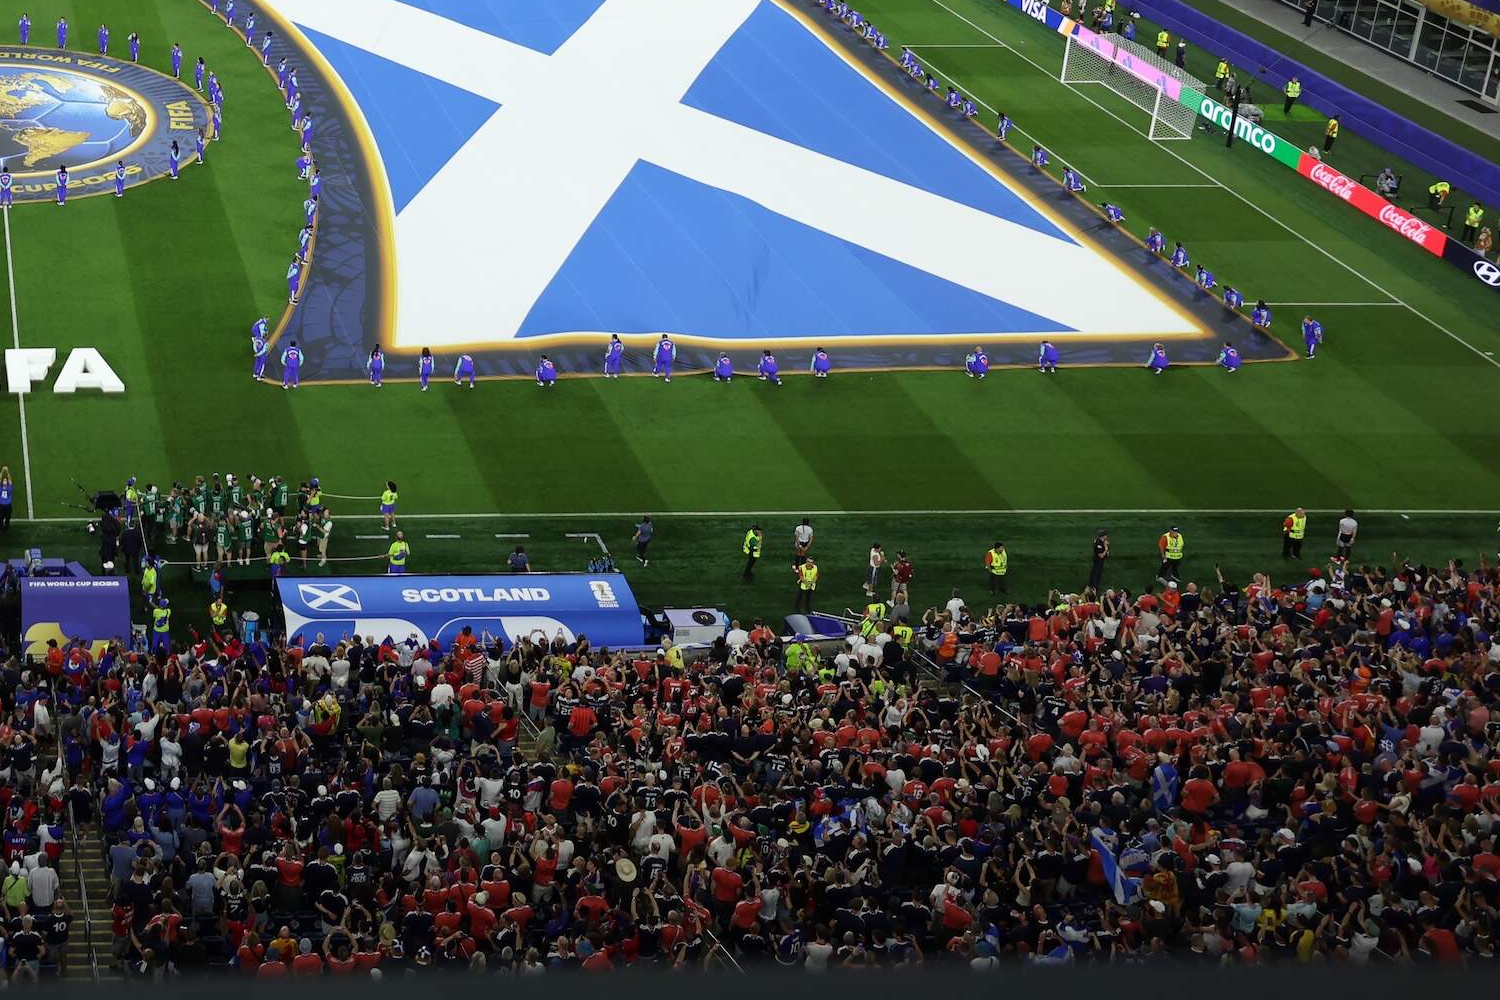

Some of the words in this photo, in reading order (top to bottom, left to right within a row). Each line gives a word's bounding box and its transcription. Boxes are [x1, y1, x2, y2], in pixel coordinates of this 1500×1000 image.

[165, 101, 194, 129] FIFA
[1201, 99, 1276, 153] aramco
[1309, 163, 1353, 201] Coca-Cola
[1378, 204, 1428, 246] Coca-Cola
[402, 587, 551, 602] SCOTLAND
[508, 789, 521, 799] 10
[53, 922, 67, 932] 10
